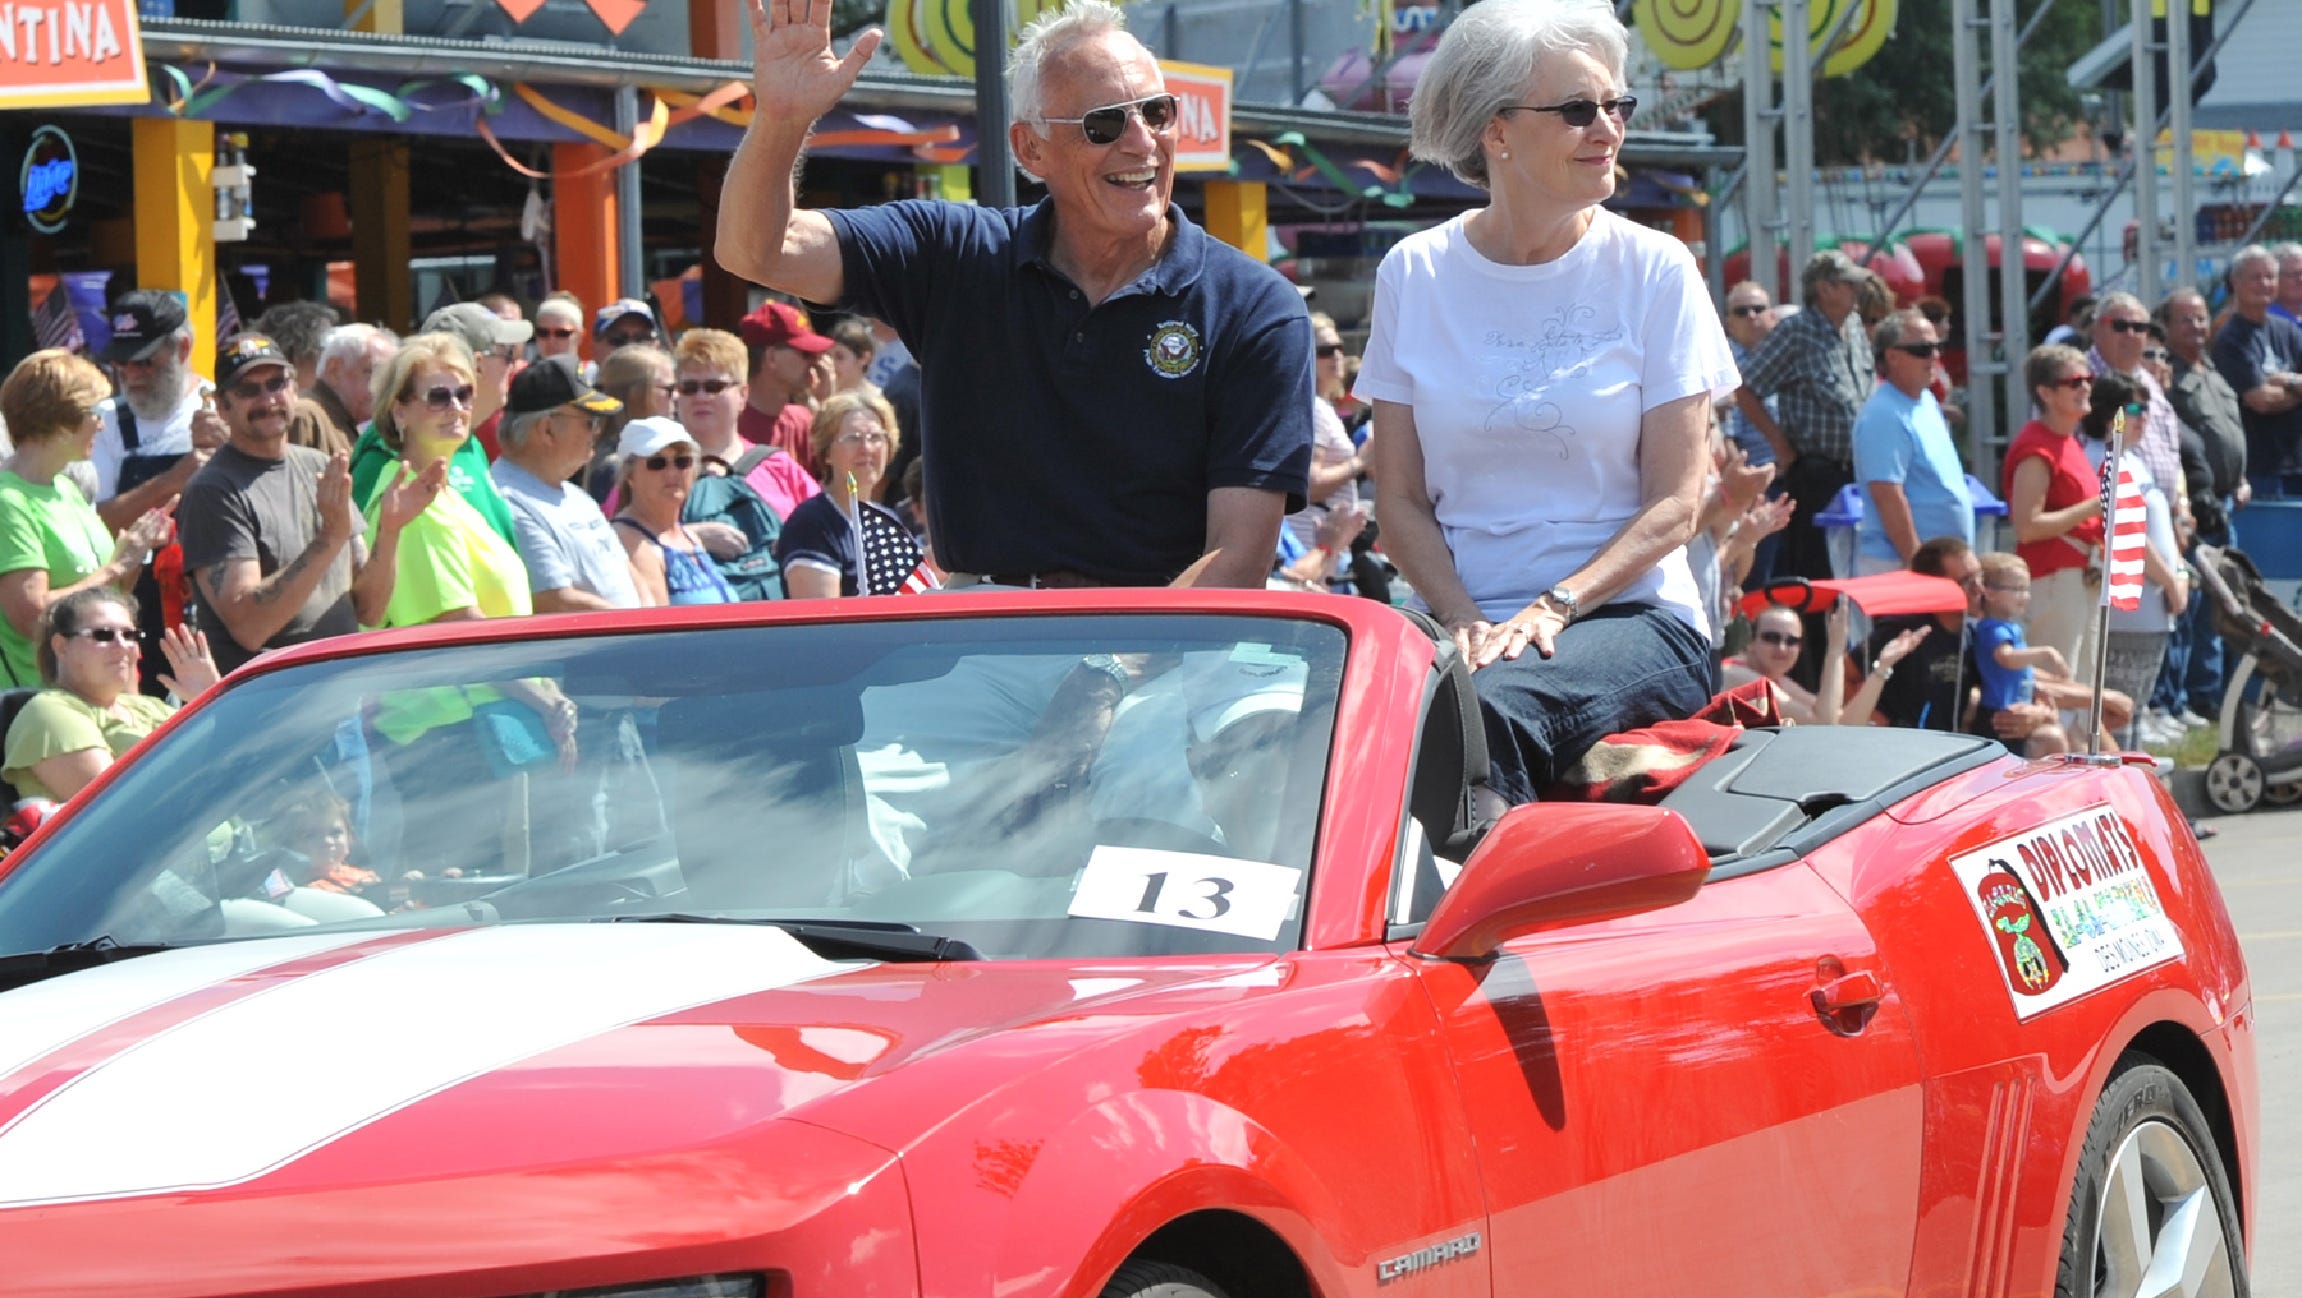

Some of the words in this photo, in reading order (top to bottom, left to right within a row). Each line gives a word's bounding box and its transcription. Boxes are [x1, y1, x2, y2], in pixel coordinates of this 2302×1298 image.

[2016, 812, 2139, 902] DIPLOMATS
[1133, 871, 1234, 919] 13
[1379, 1231, 1481, 1280] CAMARO
